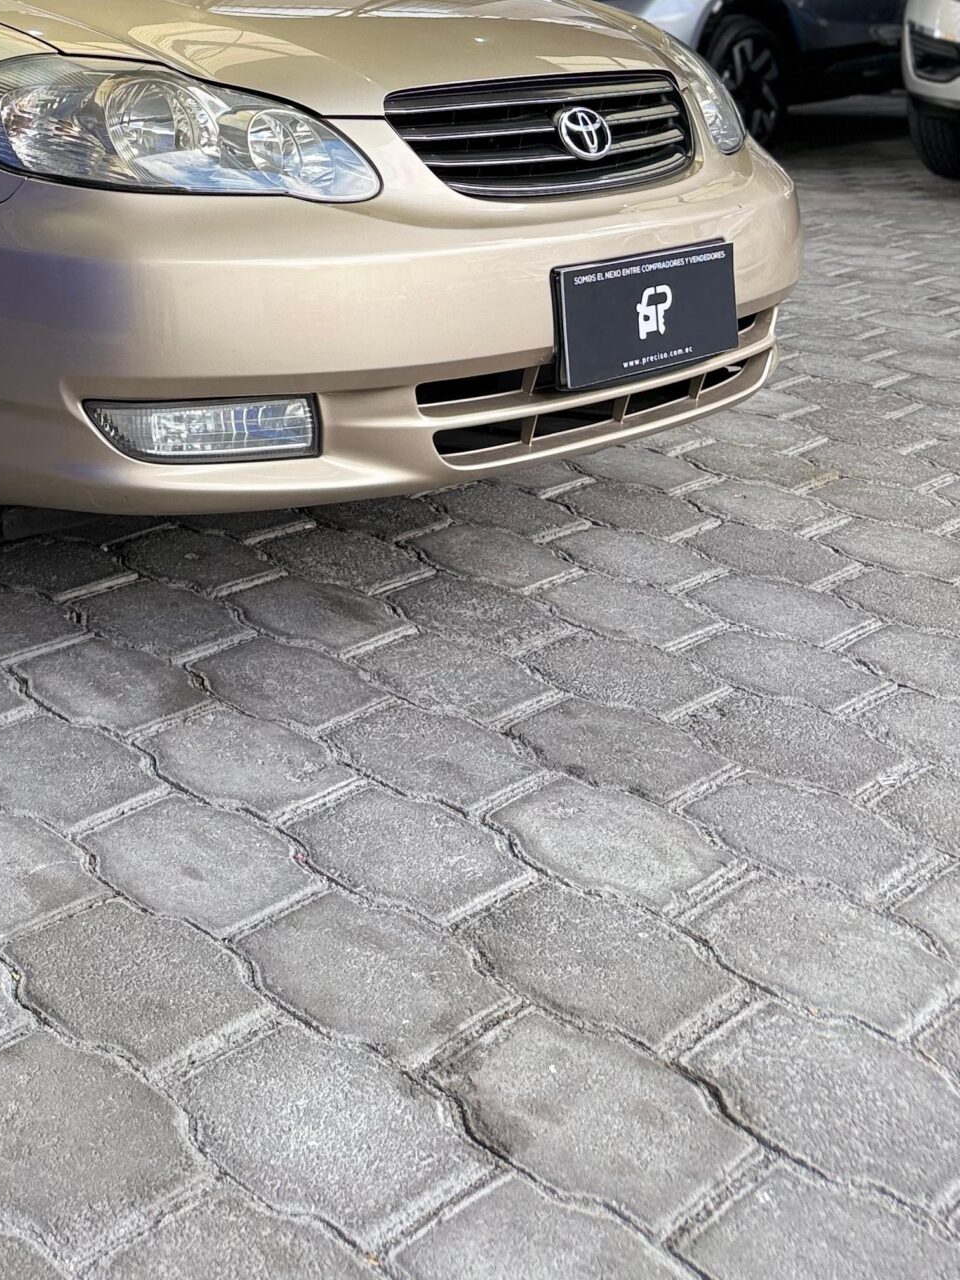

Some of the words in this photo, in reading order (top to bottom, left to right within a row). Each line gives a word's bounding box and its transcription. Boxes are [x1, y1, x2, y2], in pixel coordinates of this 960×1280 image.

[573, 273, 597, 285] SOMOS
[597, 272, 605, 281] EL
[605, 269, 622, 279] NEXO
[622, 265, 641, 276] ENTRE
[641, 257, 685, 272] COMPRADORES
[689, 250, 726, 263] VENDEDORES
[622, 346, 693, 368] www.preciso.com.ec
